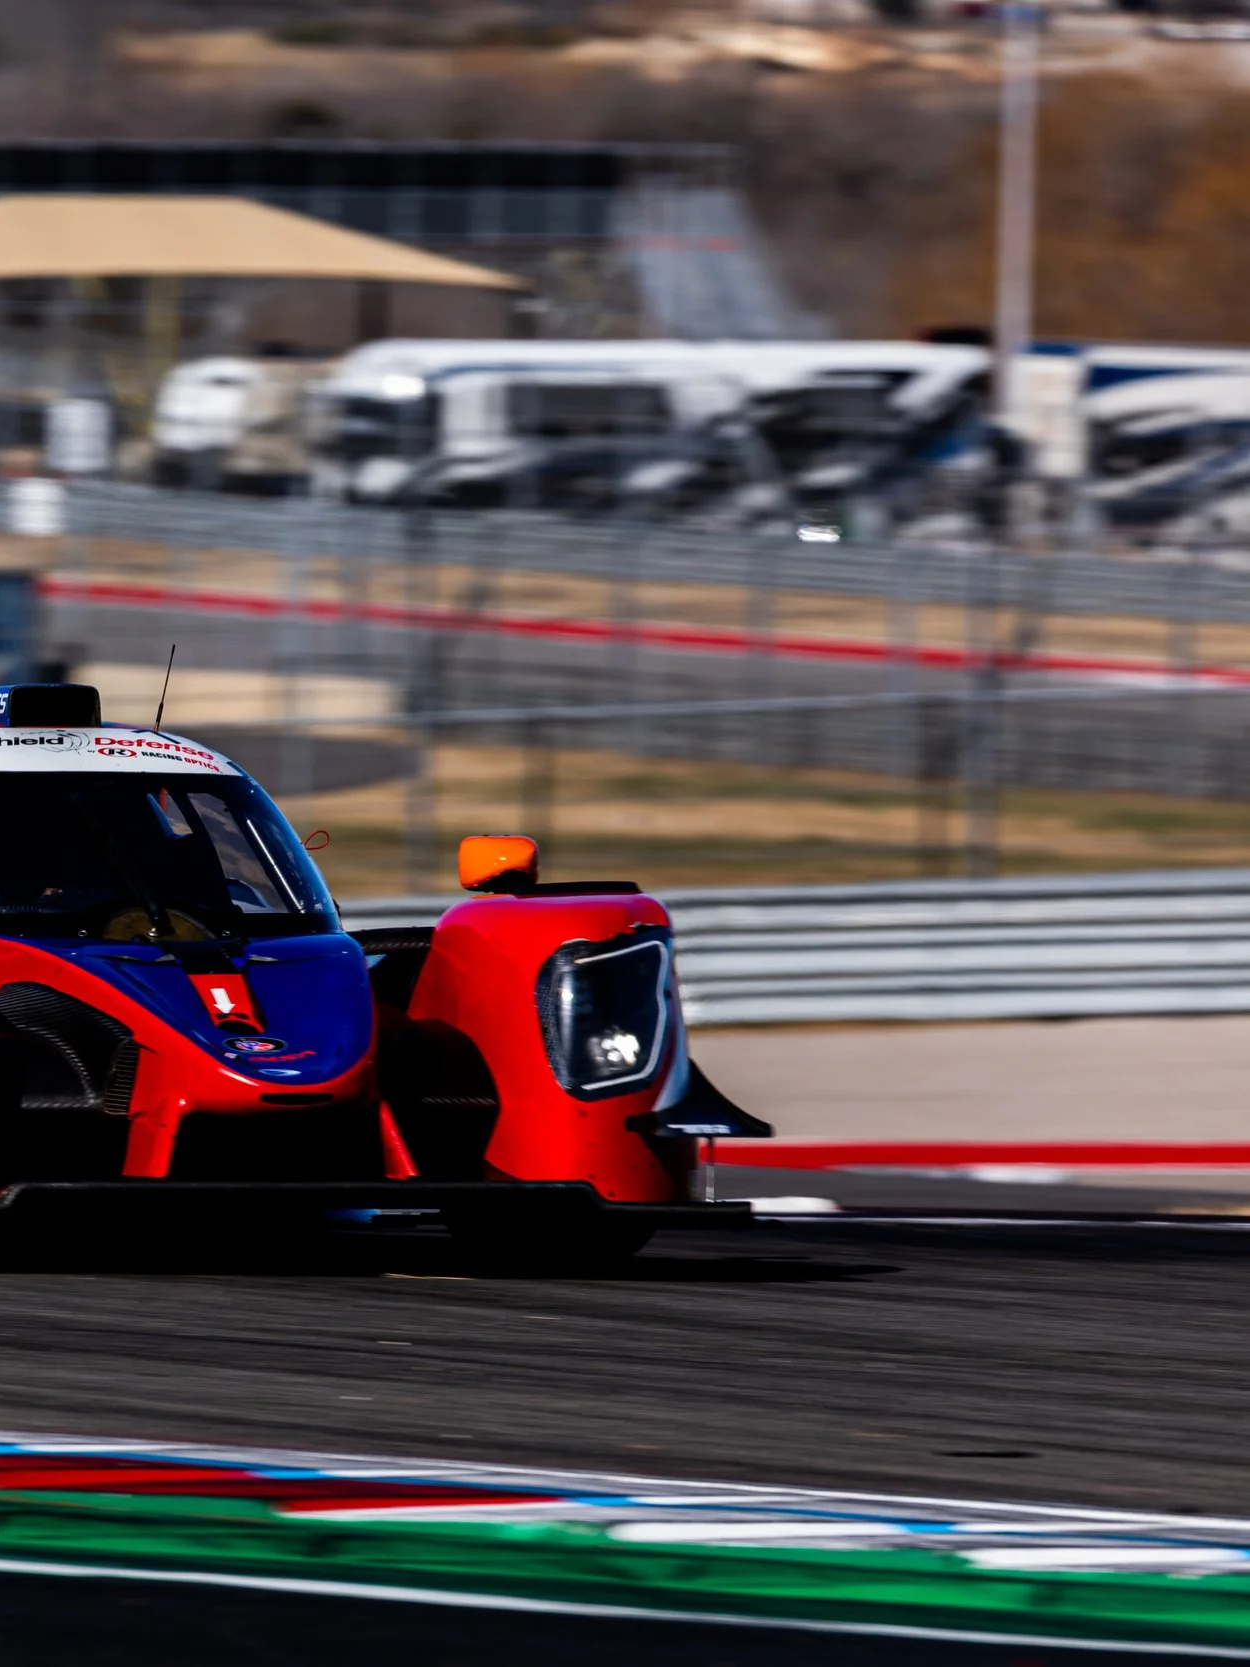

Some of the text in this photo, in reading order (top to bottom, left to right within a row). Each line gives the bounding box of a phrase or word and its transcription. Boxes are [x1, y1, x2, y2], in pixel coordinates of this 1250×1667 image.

[94, 737, 214, 761] Defense
[141, 751, 183, 762] RACING
[184, 757, 221, 772] OPTICS
